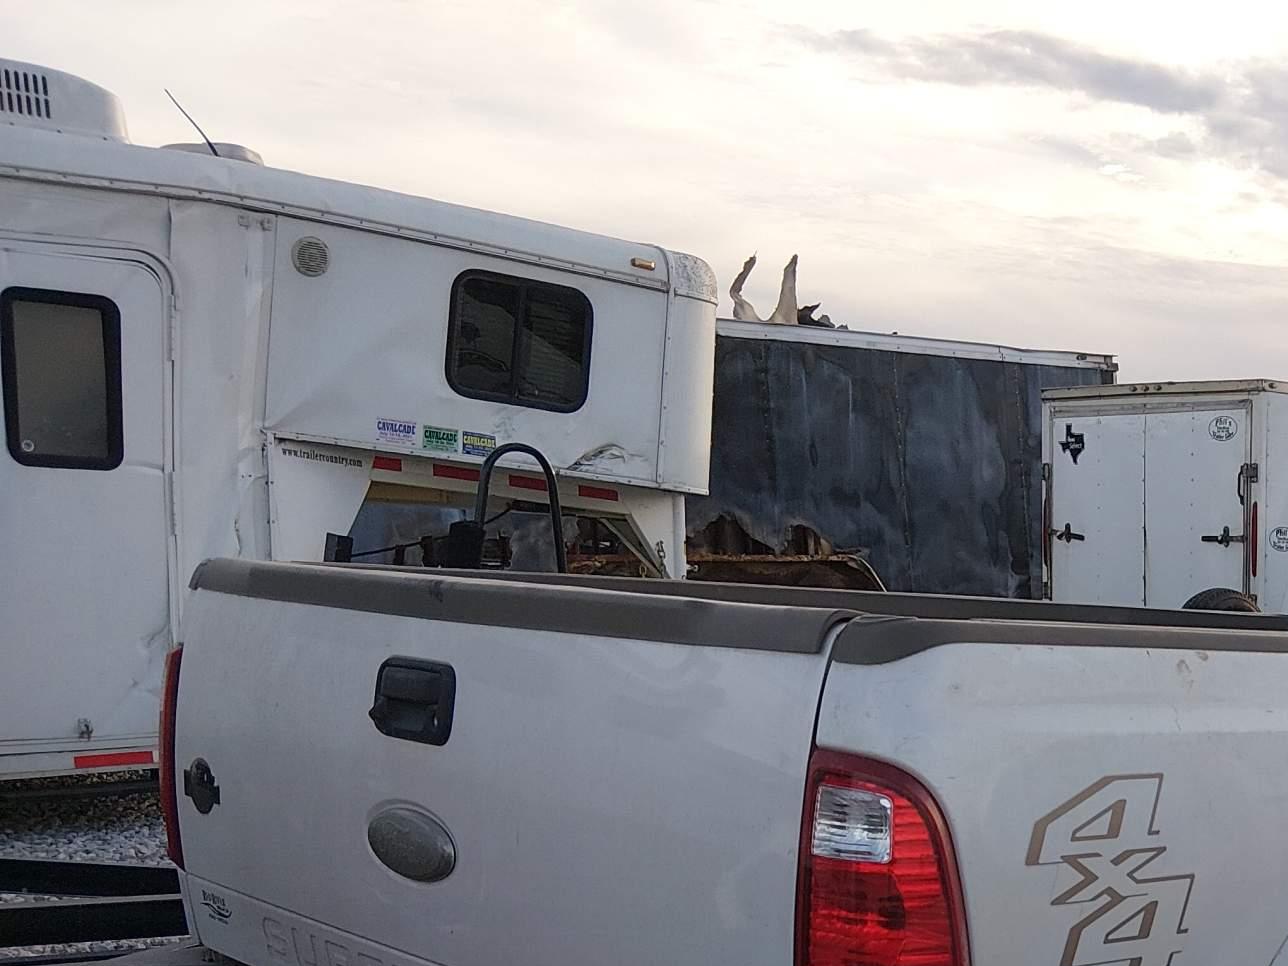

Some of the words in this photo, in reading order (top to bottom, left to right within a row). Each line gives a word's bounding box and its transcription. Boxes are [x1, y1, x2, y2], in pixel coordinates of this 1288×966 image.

[377, 420, 416, 435] CAVALCADE
[424, 429, 457, 443] CAVALCADE
[463, 435, 496, 449] CAVALCADE
[281, 448, 363, 468] www.trailercountry.com
